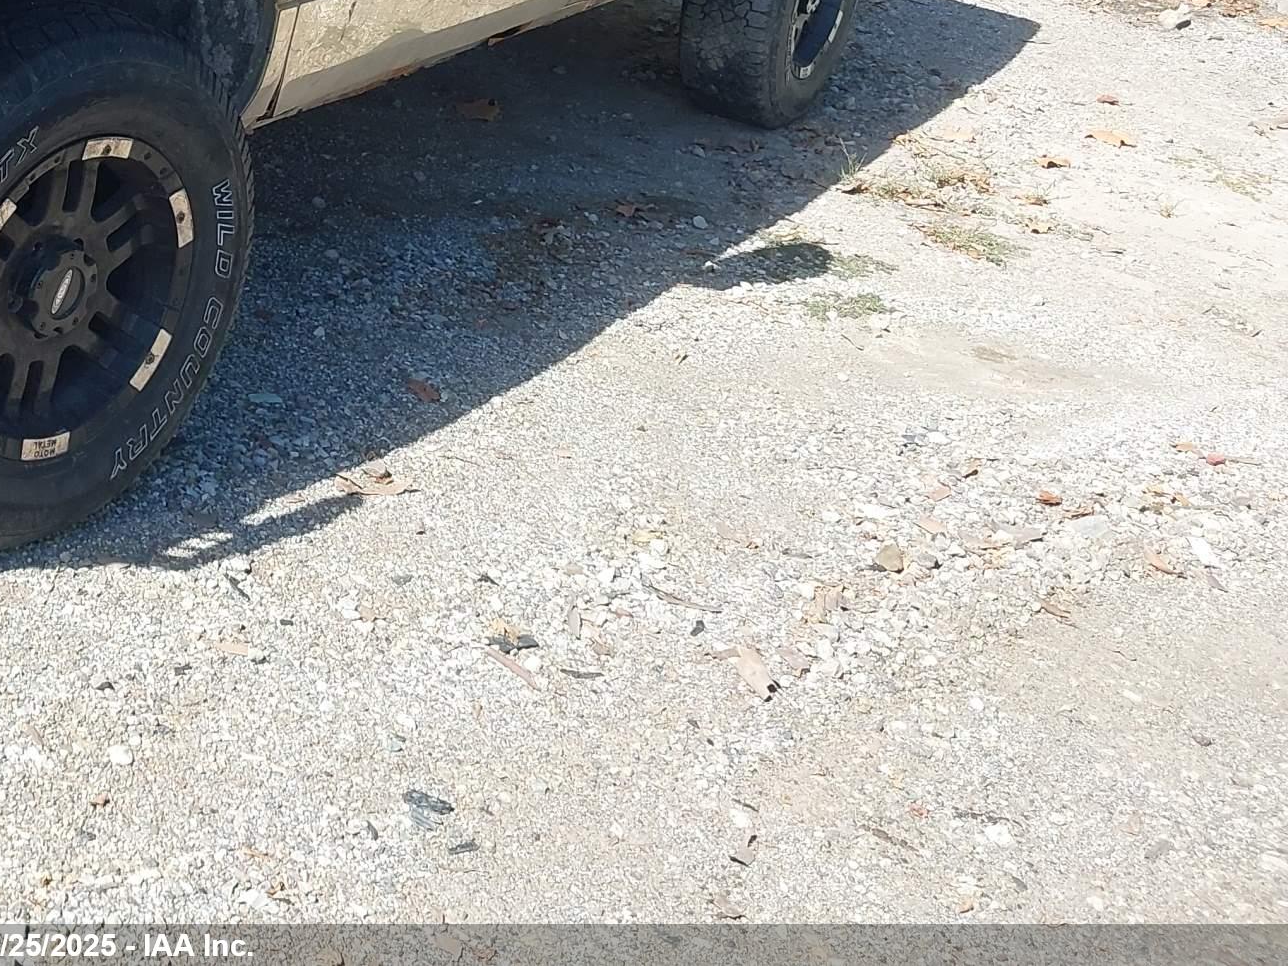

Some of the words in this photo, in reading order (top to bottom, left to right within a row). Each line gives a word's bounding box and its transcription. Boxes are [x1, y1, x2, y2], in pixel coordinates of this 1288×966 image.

[212, 178, 235, 279] WILD
[111, 297, 224, 480] COUNTRY
[33, 447, 56, 458] MOTO
